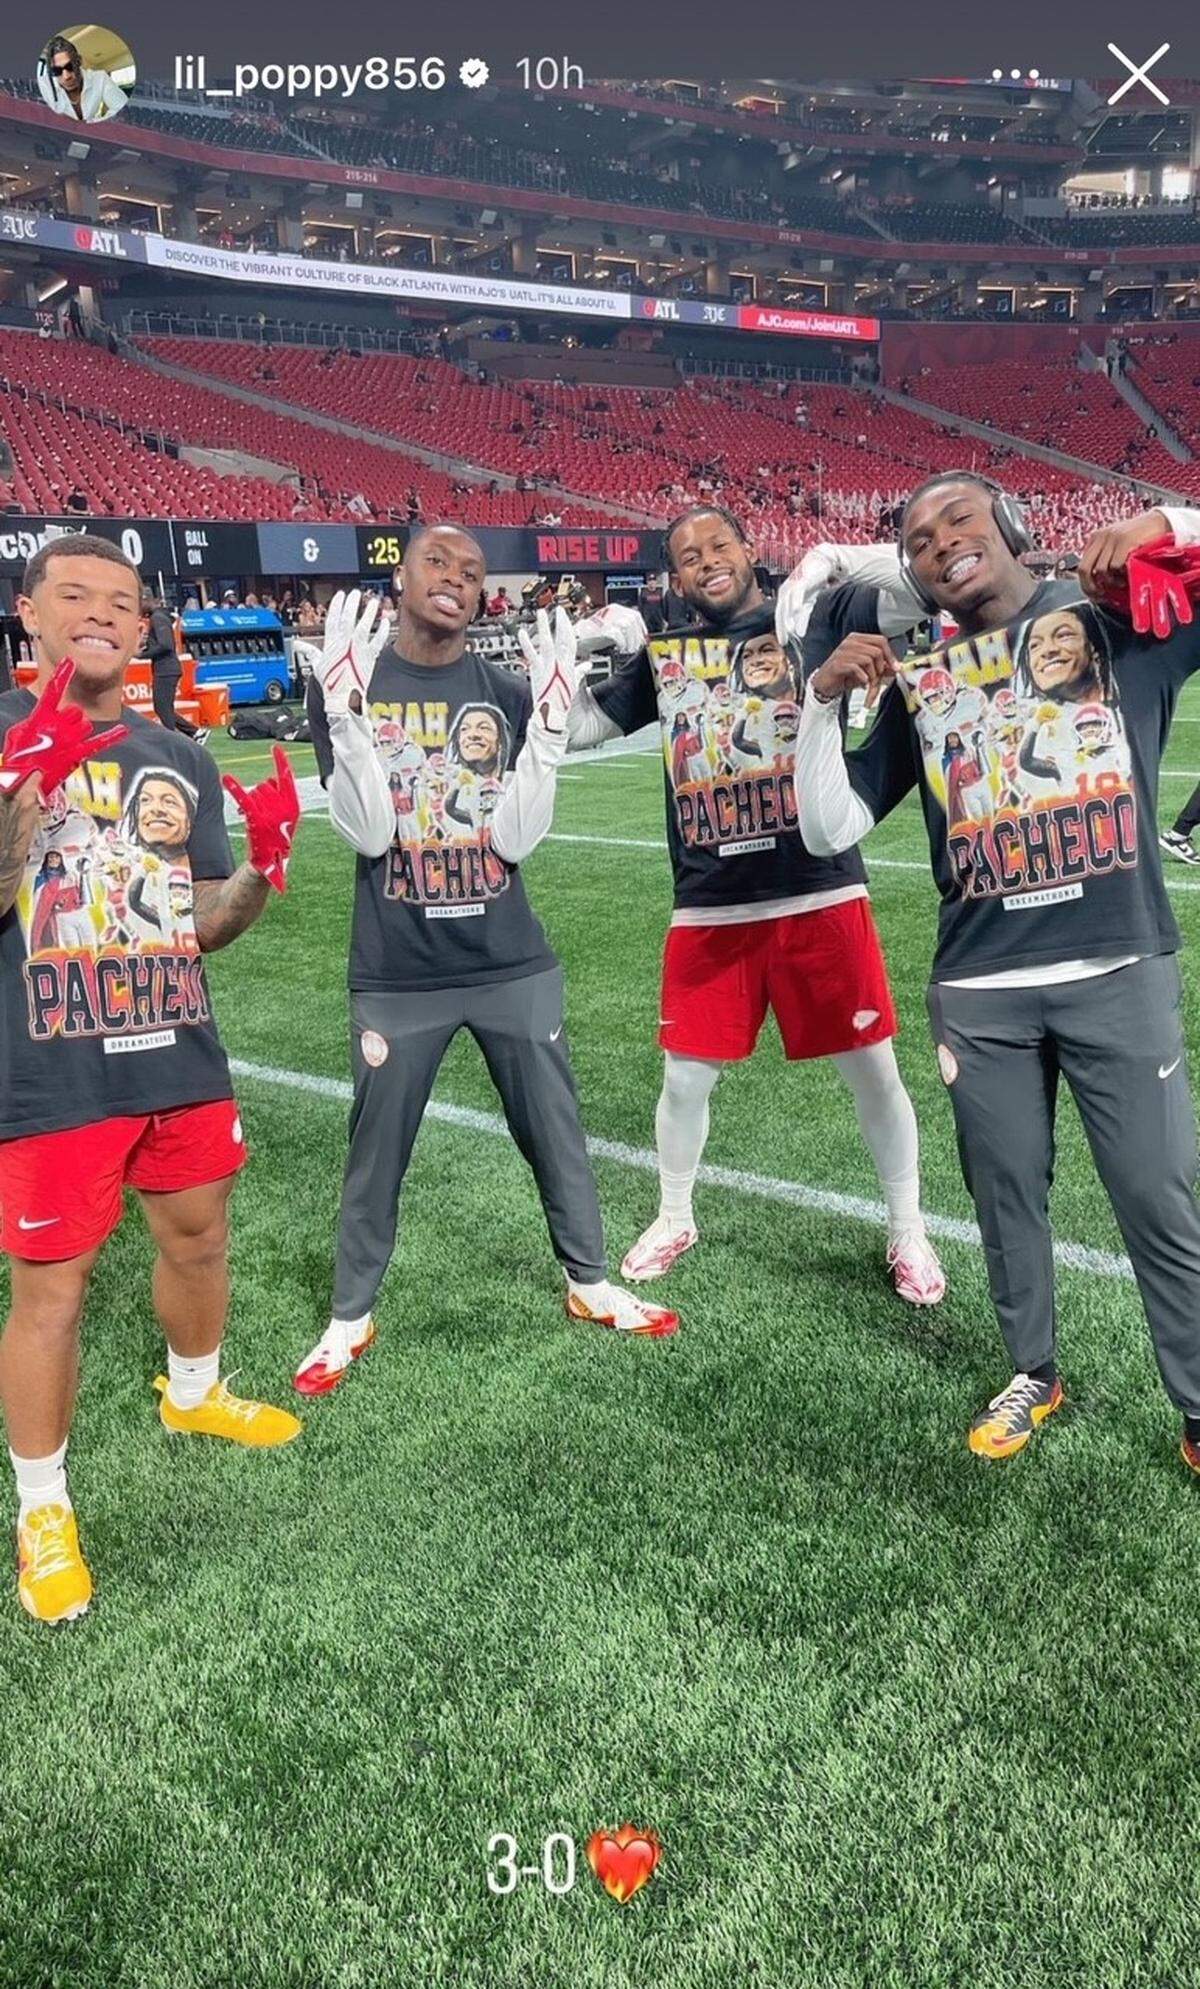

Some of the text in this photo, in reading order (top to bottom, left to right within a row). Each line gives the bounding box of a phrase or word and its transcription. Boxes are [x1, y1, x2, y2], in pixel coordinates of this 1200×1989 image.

[2, 215, 38, 240] AJC
[165, 248, 219, 269] DISCOVER
[218, 258, 240, 273] THE
[241, 262, 292, 277] VIBRANT
[294, 268, 345, 283] CULTURE
[346, 273, 362, 285] OF
[363, 274, 400, 288] BLACK
[401, 278, 450, 294] ATLANTA
[449, 282, 477, 296] WITH
[555, 294, 574, 306] ALL
[574, 296, 608, 310] ABOUT
[757, 312, 861, 336] AJC.com/JoinUATL
[121, 528, 144, 566] 0
[185, 530, 209, 547] BALL
[367, 536, 401, 565] :25
[538, 535, 639, 563] RISE UP
[187, 549, 203, 566] ON
[948, 791, 1139, 900] PACHECO
